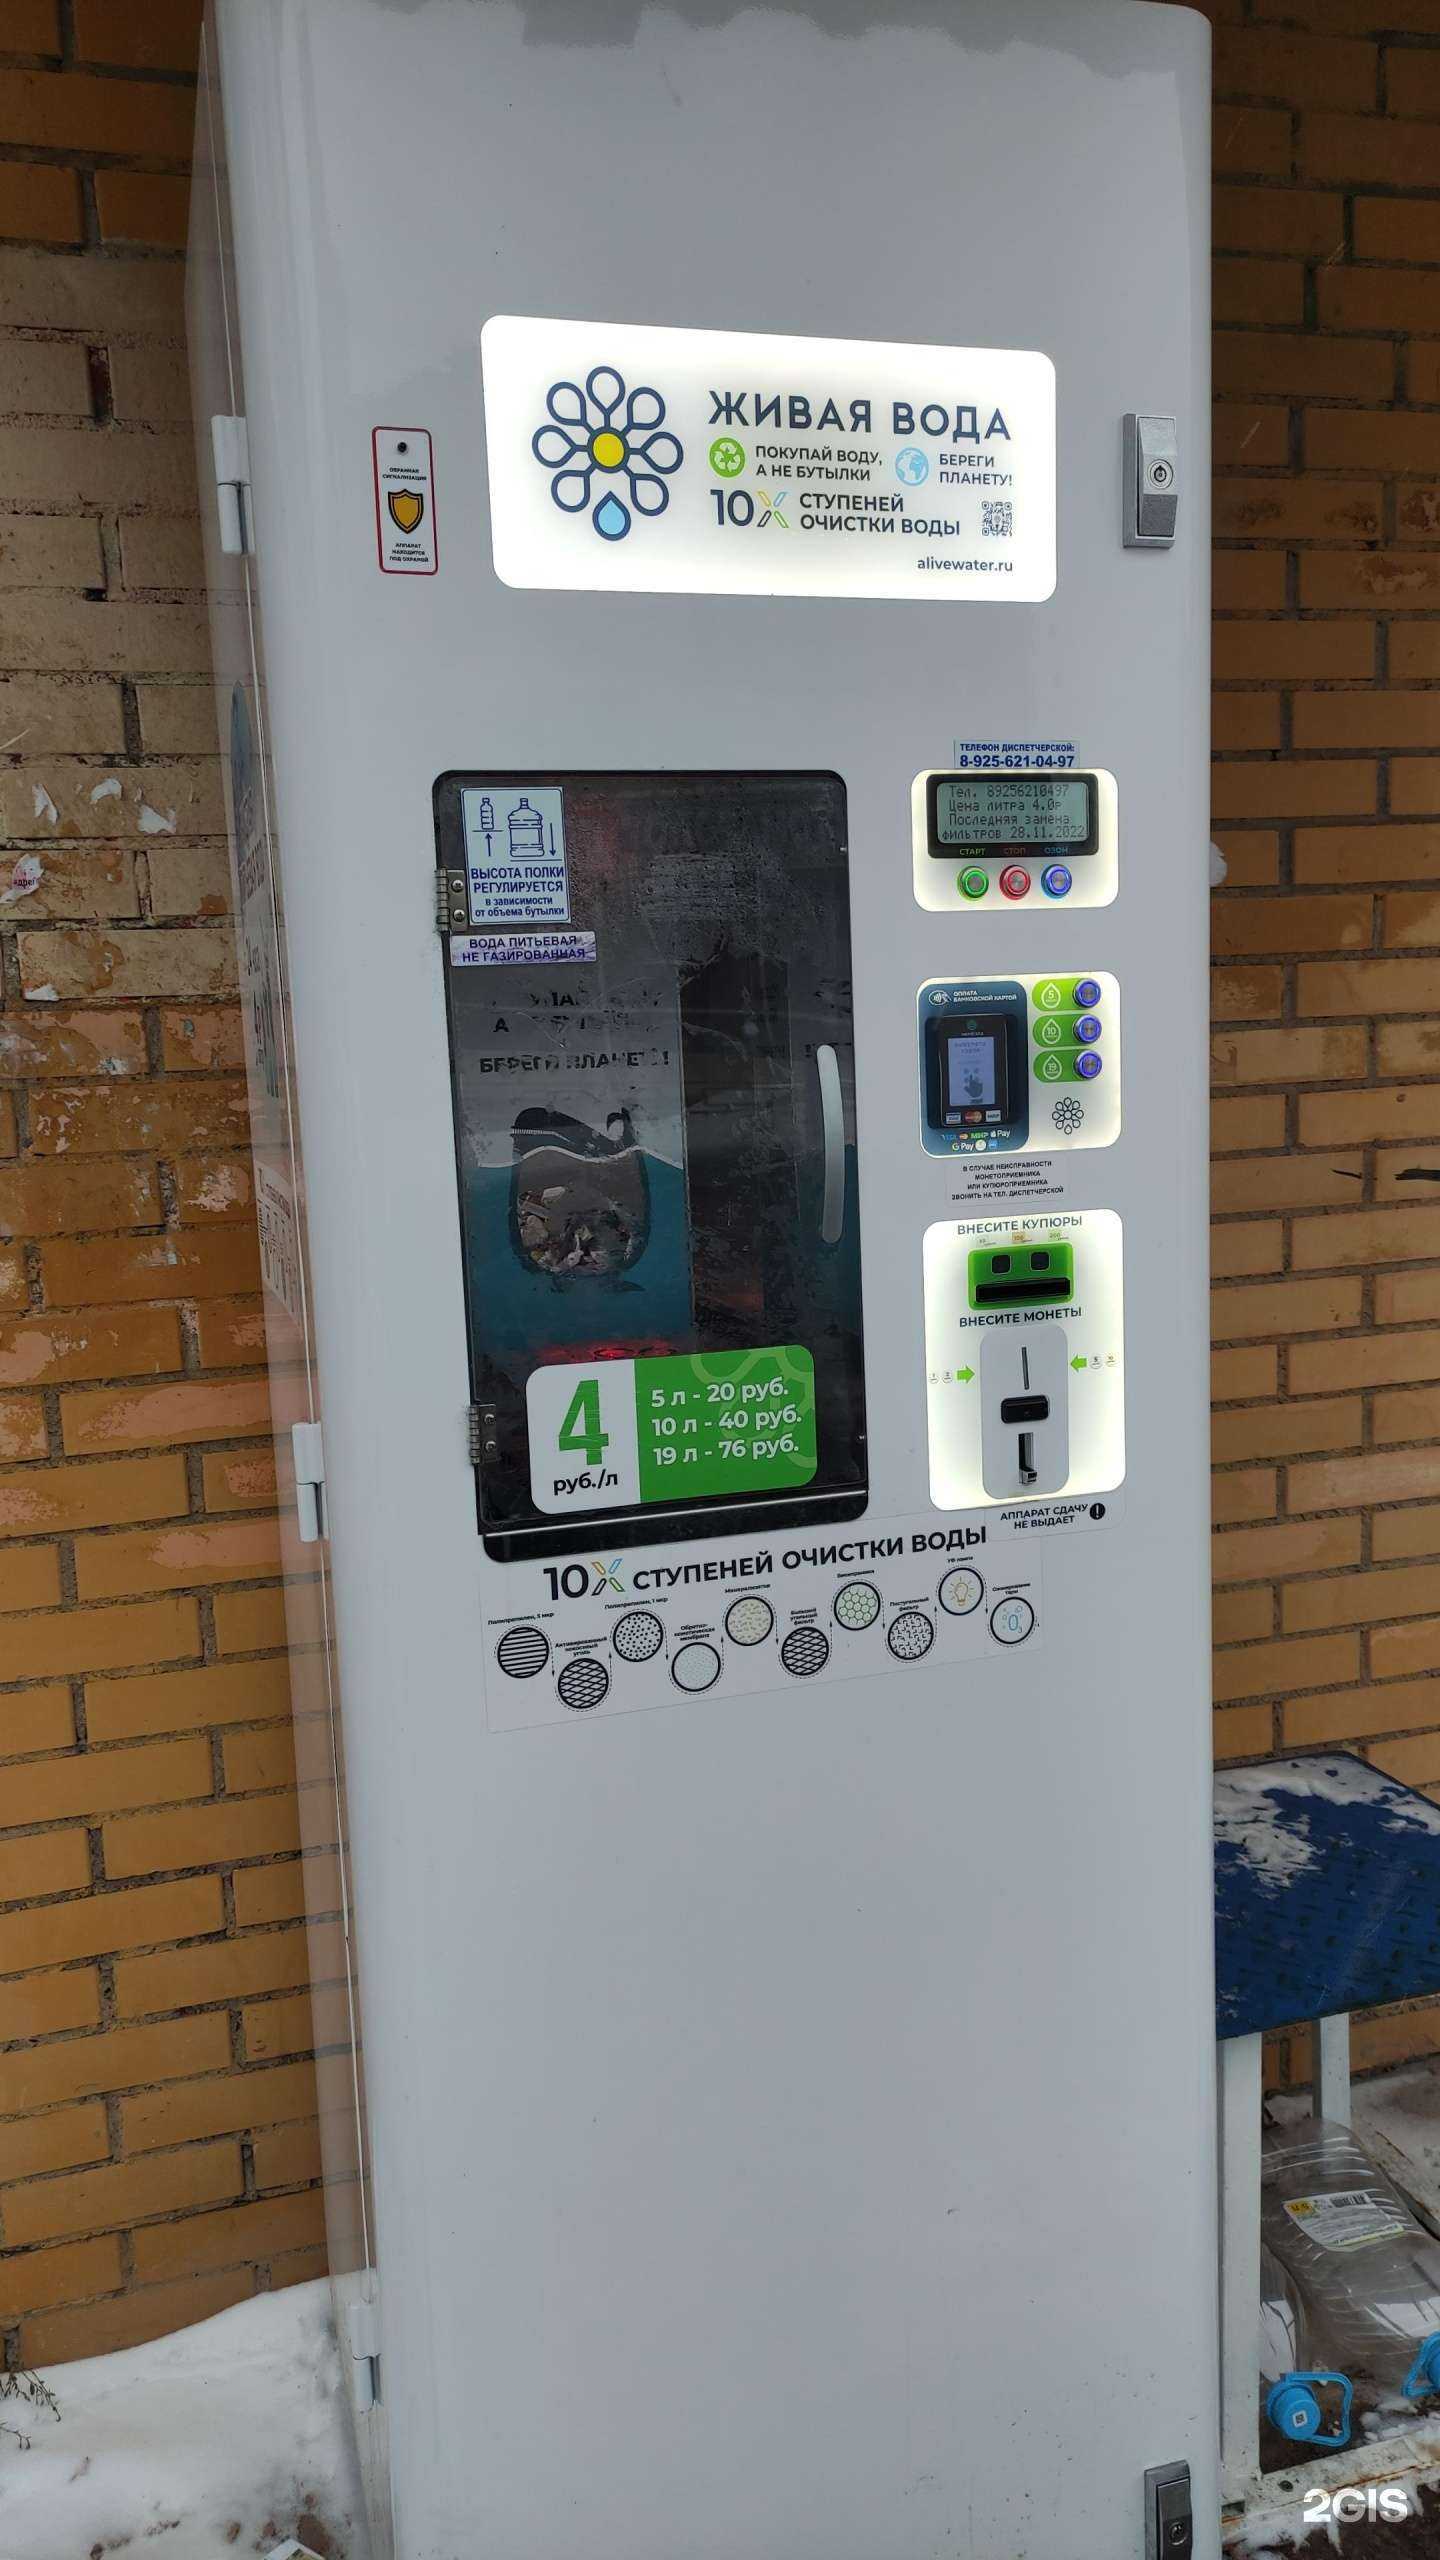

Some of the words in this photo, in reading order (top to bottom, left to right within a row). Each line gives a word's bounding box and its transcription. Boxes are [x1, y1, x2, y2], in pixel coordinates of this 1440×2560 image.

[708, 390, 872, 432] ЖИВАЯ
[892, 401, 1011, 444] ВОДА
[756, 445, 833, 462] ПОКУПАЙ
[837, 450, 883, 465] ВОДУ,
[939, 453, 994, 468] БЕРЕГИ
[756, 465, 767, 477] А
[772, 465, 791, 478] НЕ
[796, 466, 871, 481] БУТЫЛКИ
[939, 471, 1013, 486] ПЛАНЕТУ!
[800, 493, 904, 512] СТУПЕНЕЙ
[800, 515, 895, 533] ОЧИСТКИ
[901, 519, 960, 537] ВОДЫ
[917, 556, 1013, 572] alivewater.ru
[960, 743, 1000, 752] ТЕЛЕФОН
[1001, 743, 1075, 753] ДИСПЕТЧЕРСКОЙ:
[960, 755, 1075, 768] 8-925-621-04-97
[950, 786, 977, 798] Тел.
[986, 784, 1069, 798] 89256210497
[949, 800, 980, 812] Цена
[986, 801, 1025, 812] литра
[949, 814, 1018, 827] Последняя
[1025, 815, 1070, 825] замена
[1010, 825, 1085, 839] 28.11.2022
[959, 847, 986, 856] СТАРТ
[471, 868, 521, 880] ВЫСОТА
[525, 866, 565, 878] ПОЛКИ
[473, 881, 563, 894] РЕГУЛИРУЕТСЯ
[493, 897, 553, 906] зависимости
[475, 909, 485, 917] от
[488, 907, 523, 917] объема
[525, 906, 565, 918] бутылки
[469, 938, 505, 950] ВОДА
[509, 935, 577, 948] ПИТЬЕВАЯ
[462, 952, 479, 962] НЕ
[483, 948, 586, 962] ГАЗИРОВАННАЯ
[1048, 991, 1054, 999] 5
[997, 1130, 1011, 1138] Pay
[961, 1142, 974, 1151] Pay
[969, 1164, 994, 1172] СЛУЧАЕ
[996, 1160, 1052, 1170] НЕИСПРАВНОСТИ
[975, 1171, 1041, 1180] МОНЕТОПРИЕМНИКА
[982, 1179, 1048, 1189] КУПЮРОПРИЕМНИКА
[1009, 1186, 1064, 1197] ДИСПЕТЧЕРСКОЙ
[957, 1220, 1018, 1235] ВНЕСИТЕ
[1022, 1215, 1083, 1230] КУПЮРЫ
[959, 1312, 1020, 1328] ВНЕСИТЕ
[1024, 1307, 1082, 1322] МОНЕТЫ
[652, 1389, 664, 1408] 5
[671, 1390, 686, 1406] л
[706, 1382, 735, 1403] 20
[742, 1377, 789, 1403] руб.
[558, 1379, 609, 1466] 4
[652, 1418, 676, 1436] 10
[683, 1418, 697, 1433] л
[718, 1411, 748, 1430] 40
[755, 1404, 802, 1431] руб.
[653, 1447, 676, 1466] 19
[683, 1446, 697, 1463] л
[719, 1440, 746, 1459] 76
[752, 1433, 798, 1460] руб.
[553, 1469, 618, 1496] руб./л
[1000, 1507, 1051, 1521] АППАРАТ
[1053, 1504, 1088, 1516] СДАЧУ
[1014, 1519, 1028, 1529] НЕ
[1031, 1516, 1075, 1528] ВЫДАЕТ
[633, 1550, 773, 1590] СТУПЕНЕЙ
[782, 1537, 903, 1570] ОЧИСТКИ
[912, 1526, 986, 1552] ВОДЫ
